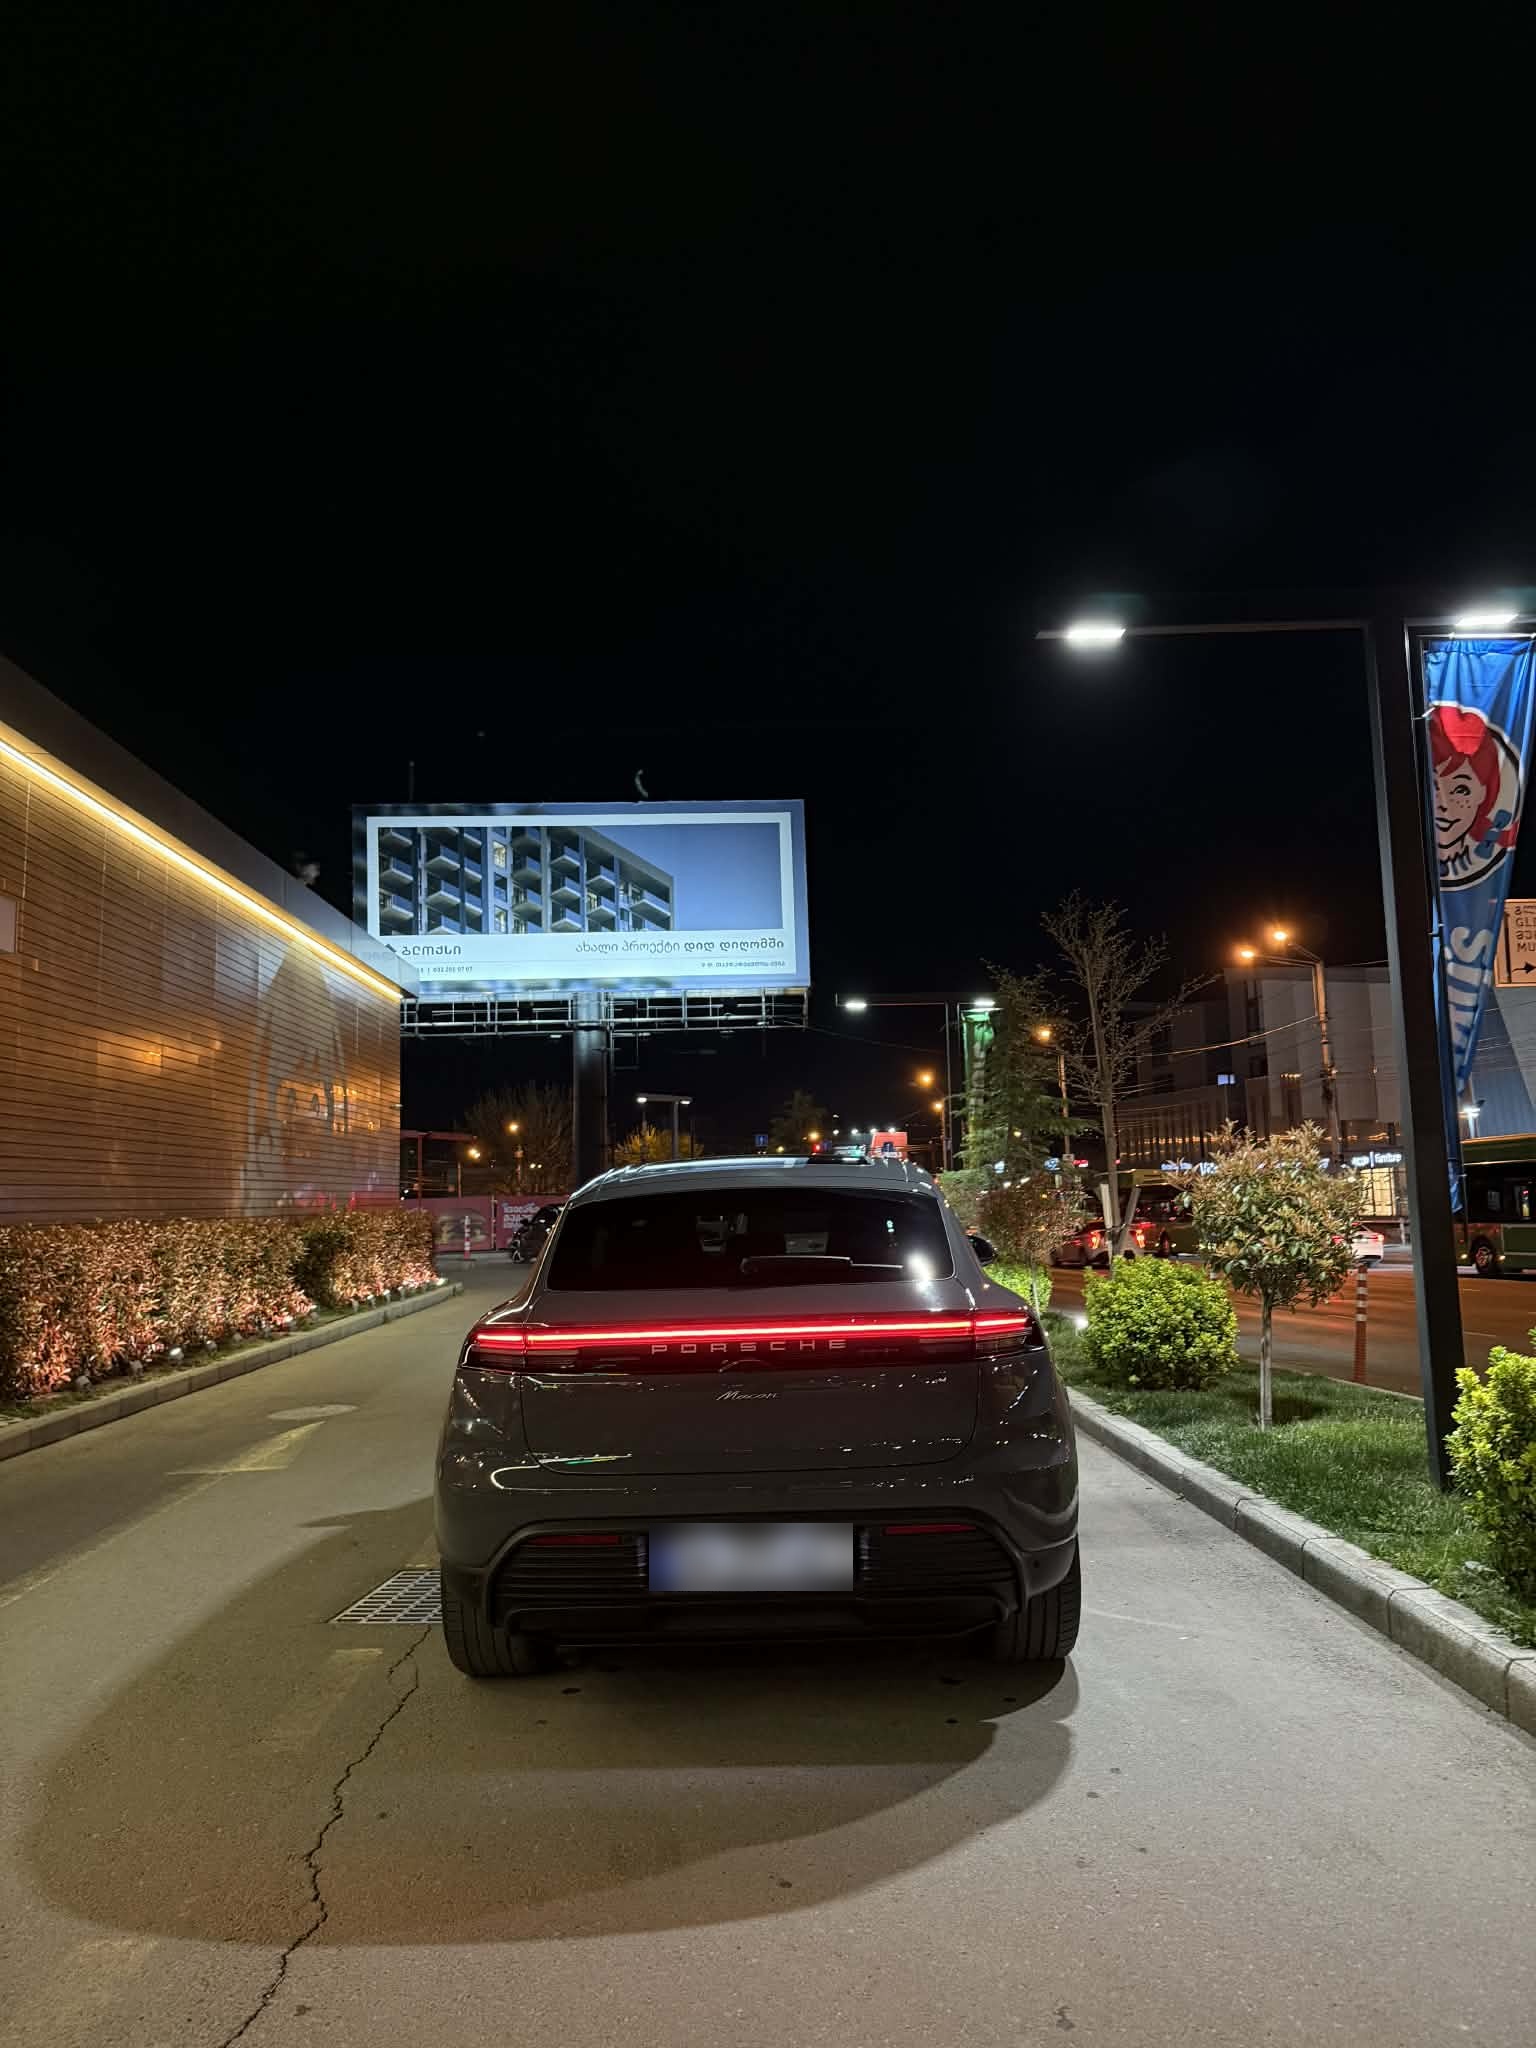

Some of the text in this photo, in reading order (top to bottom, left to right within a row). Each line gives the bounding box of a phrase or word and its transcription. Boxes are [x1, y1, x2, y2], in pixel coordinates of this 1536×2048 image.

[575, 937, 785, 955] ახალი პროექტი დიდ დიღომში
[651, 1339, 847, 1356] PORSCHE
[715, 1390, 778, 1401] Macan
